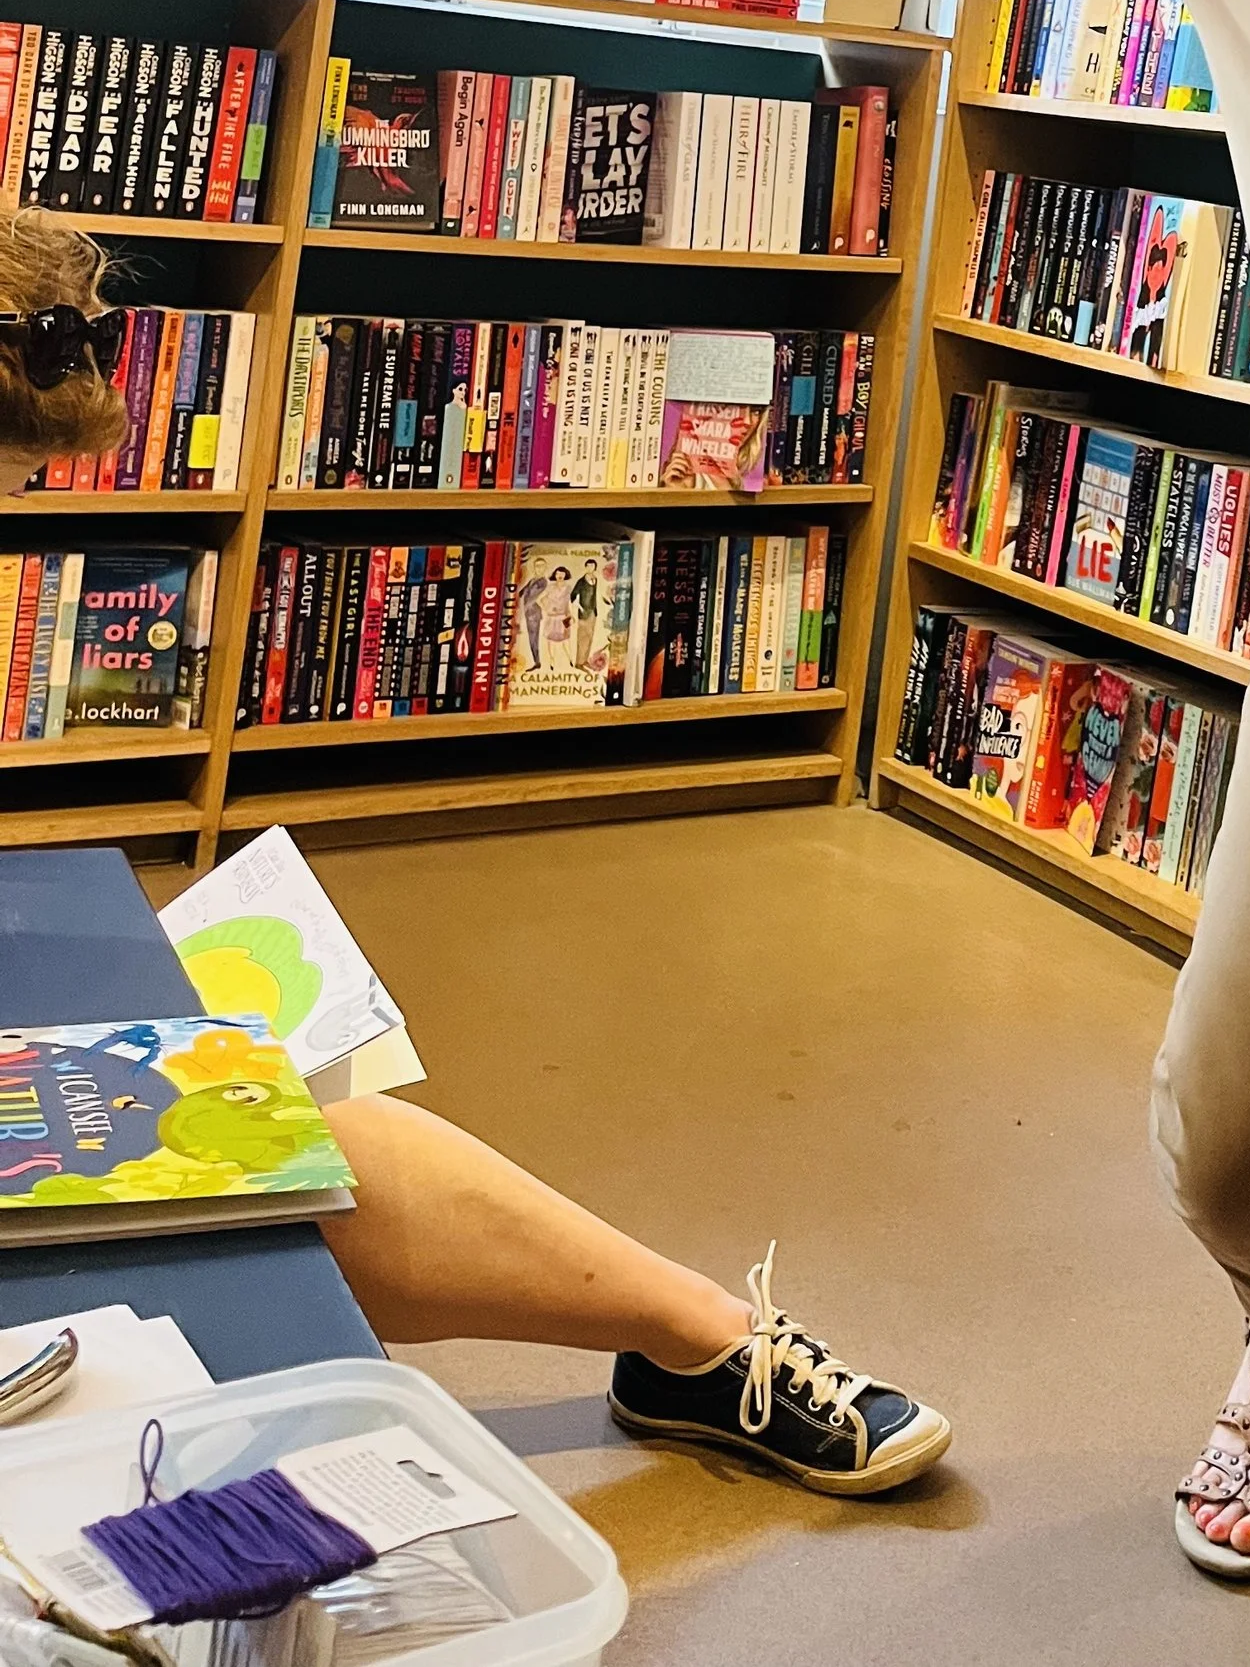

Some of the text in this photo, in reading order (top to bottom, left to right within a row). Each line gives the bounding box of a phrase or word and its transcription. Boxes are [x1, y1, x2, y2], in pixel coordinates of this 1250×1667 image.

[40, 32, 61, 83] HIGSON
[70, 35, 92, 86] HIGSON
[104, 37, 125, 89] HIGSON
[1118, 38, 1128, 57] YOU
[134, 44, 155, 95] HIGSON
[167, 45, 188, 96] HIGSON
[197, 48, 218, 98] HIGSON
[59, 95, 85, 171] DEAD
[217, 70, 246, 170] AFTER THE FIRE
[375, 118, 390, 128] THE
[453, 76, 474, 148] Begin Again
[584, 102, 652, 148] ET'S
[738, 105, 752, 138] HEIR
[28, 92, 57, 189] ENEMY
[92, 97, 121, 174] FEAR
[154, 104, 183, 199] FALLEN
[182, 105, 214, 200] HUNTED
[341, 128, 431, 148] UMMINGBIRD
[356, 146, 410, 169] KILLER
[580, 145, 649, 187] LAY
[735, 151, 749, 182] FIRE
[340, 204, 424, 216] FINN LONGMAN
[453, 328, 466, 376] ROYALS
[583, 368, 593, 378] OF
[361, 371, 371, 393] TAKE
[380, 355, 397, 409] SUPREME
[563, 342, 580, 427] ONE OF US IS LYING
[582, 381, 592, 392] US
[822, 346, 837, 405] CURSED
[857, 381, 871, 409] BOY
[359, 396, 368, 408] ME
[579, 406, 590, 427] NEXT
[581, 395, 590, 404] IS
[649, 376, 664, 426] COUSINS
[357, 410, 367, 436] HOME
[378, 412, 392, 430] LIE
[1161, 470, 1183, 548] STATELESS
[1202, 473, 1223, 567] MUST BETTER
[1217, 485, 1237, 553] UGLIES
[1175, 503, 1191, 560] APOCALYPSE
[654, 549, 667, 601] NESS
[673, 550, 689, 604] NESS
[1076, 535, 1113, 583] LIE
[83, 584, 179, 617] amily
[299, 553, 316, 617] ALL OUT
[348, 569, 360, 603] LAST
[697, 591, 706, 614] SILENT
[699, 577, 708, 590] THE
[104, 616, 141, 642] of
[344, 607, 356, 639] GIRL
[361, 606, 379, 669] THE END
[475, 586, 497, 692] DUMPLIN'
[495, 583, 517, 686] PUMPKIN
[695, 636, 703, 647] GO
[696, 615, 704, 634] STARS
[81, 643, 153, 670] liars
[728, 623, 743, 682] MOLECULES
[509, 685, 600, 699] MANNERINGS
[520, 674, 582, 685] CALAMITY
[584, 673, 599, 684] OF
[980, 705, 1003, 733] BAD
[978, 735, 1021, 758] INFLUENCE
[59, 1081, 104, 1112] CAN
[69, 1112, 113, 1135] SEE
